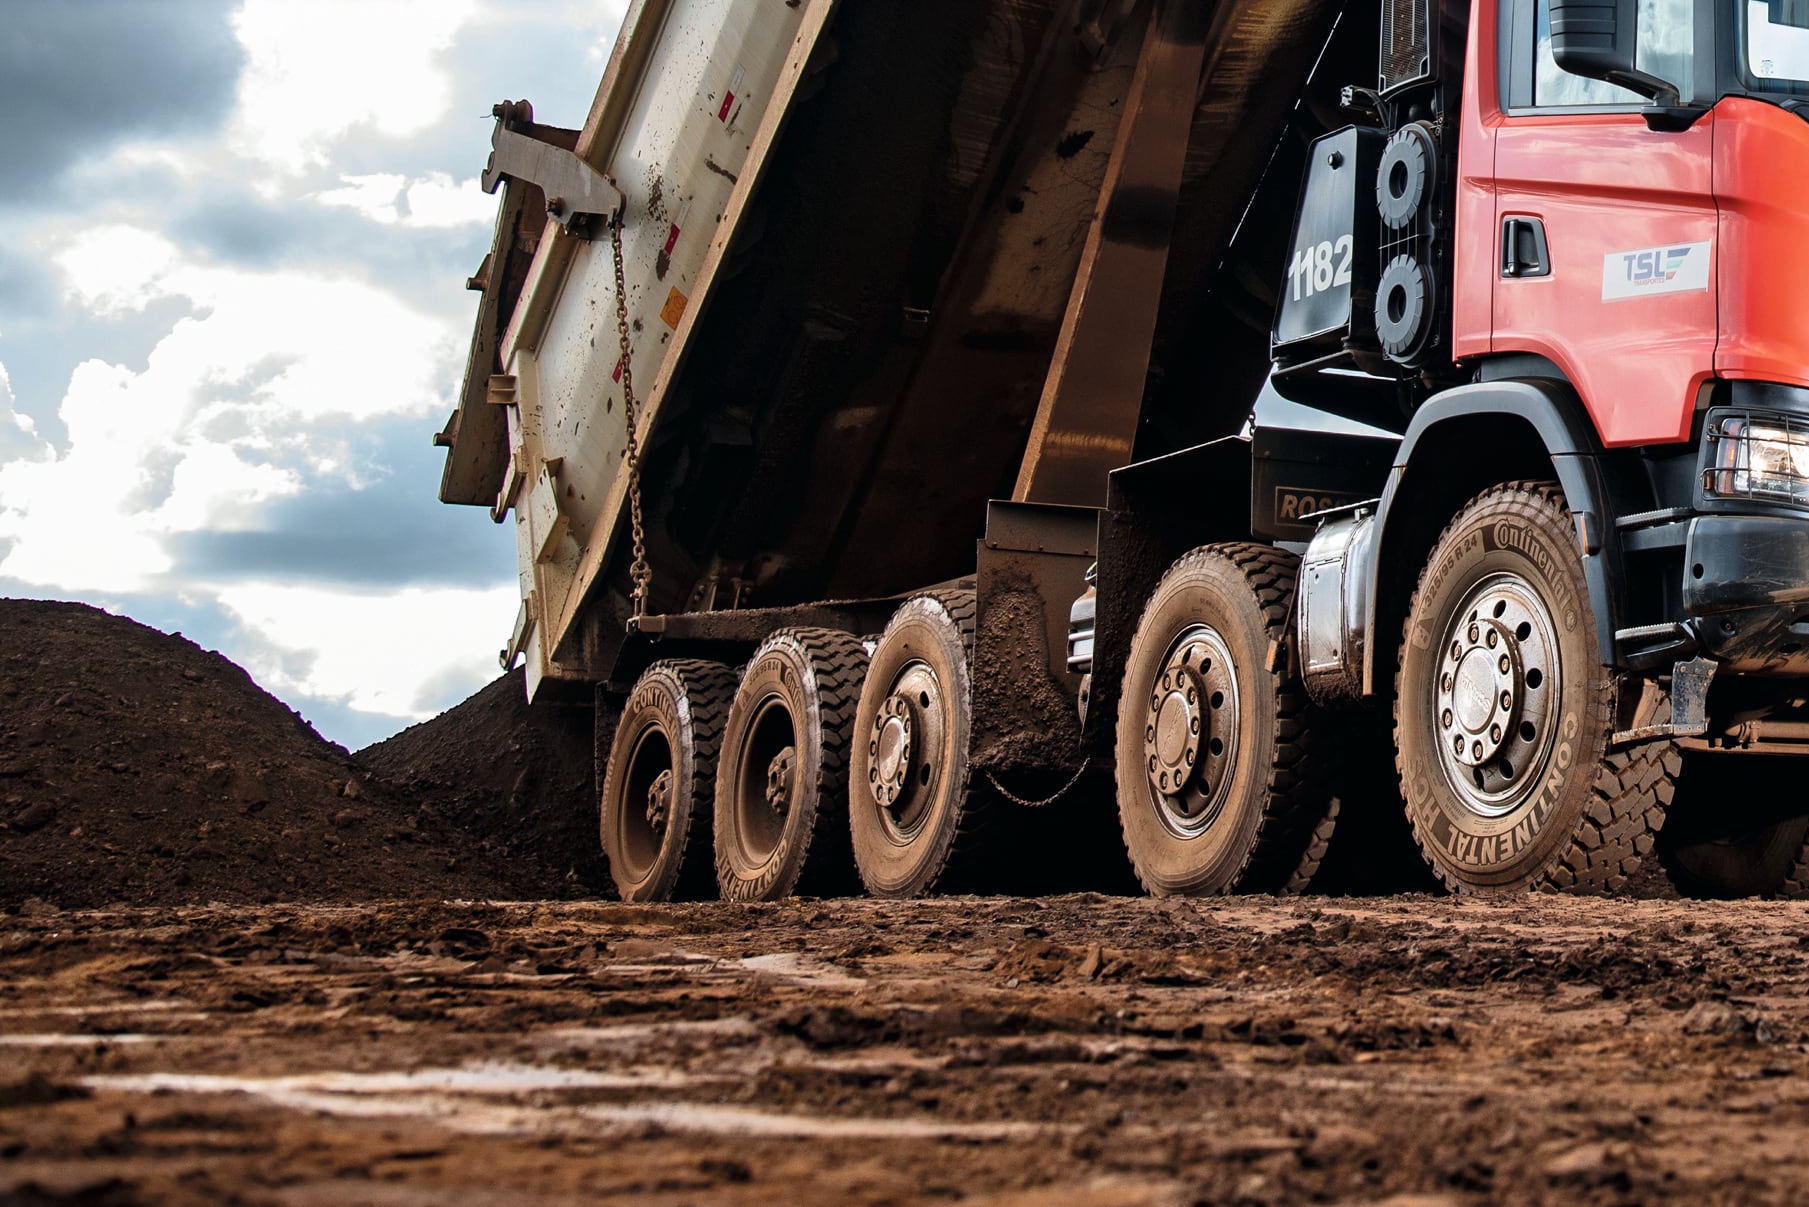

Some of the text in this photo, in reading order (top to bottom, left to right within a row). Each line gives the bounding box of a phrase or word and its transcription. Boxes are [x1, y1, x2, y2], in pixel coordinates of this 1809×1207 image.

[1288, 234, 1353, 301] 1182
[1624, 251, 1665, 280] TSL
[1424, 535, 1478, 608] 325/95 R 24
[1493, 518, 1573, 609] Continental
[1447, 711, 1578, 866] CONTINENTAL
